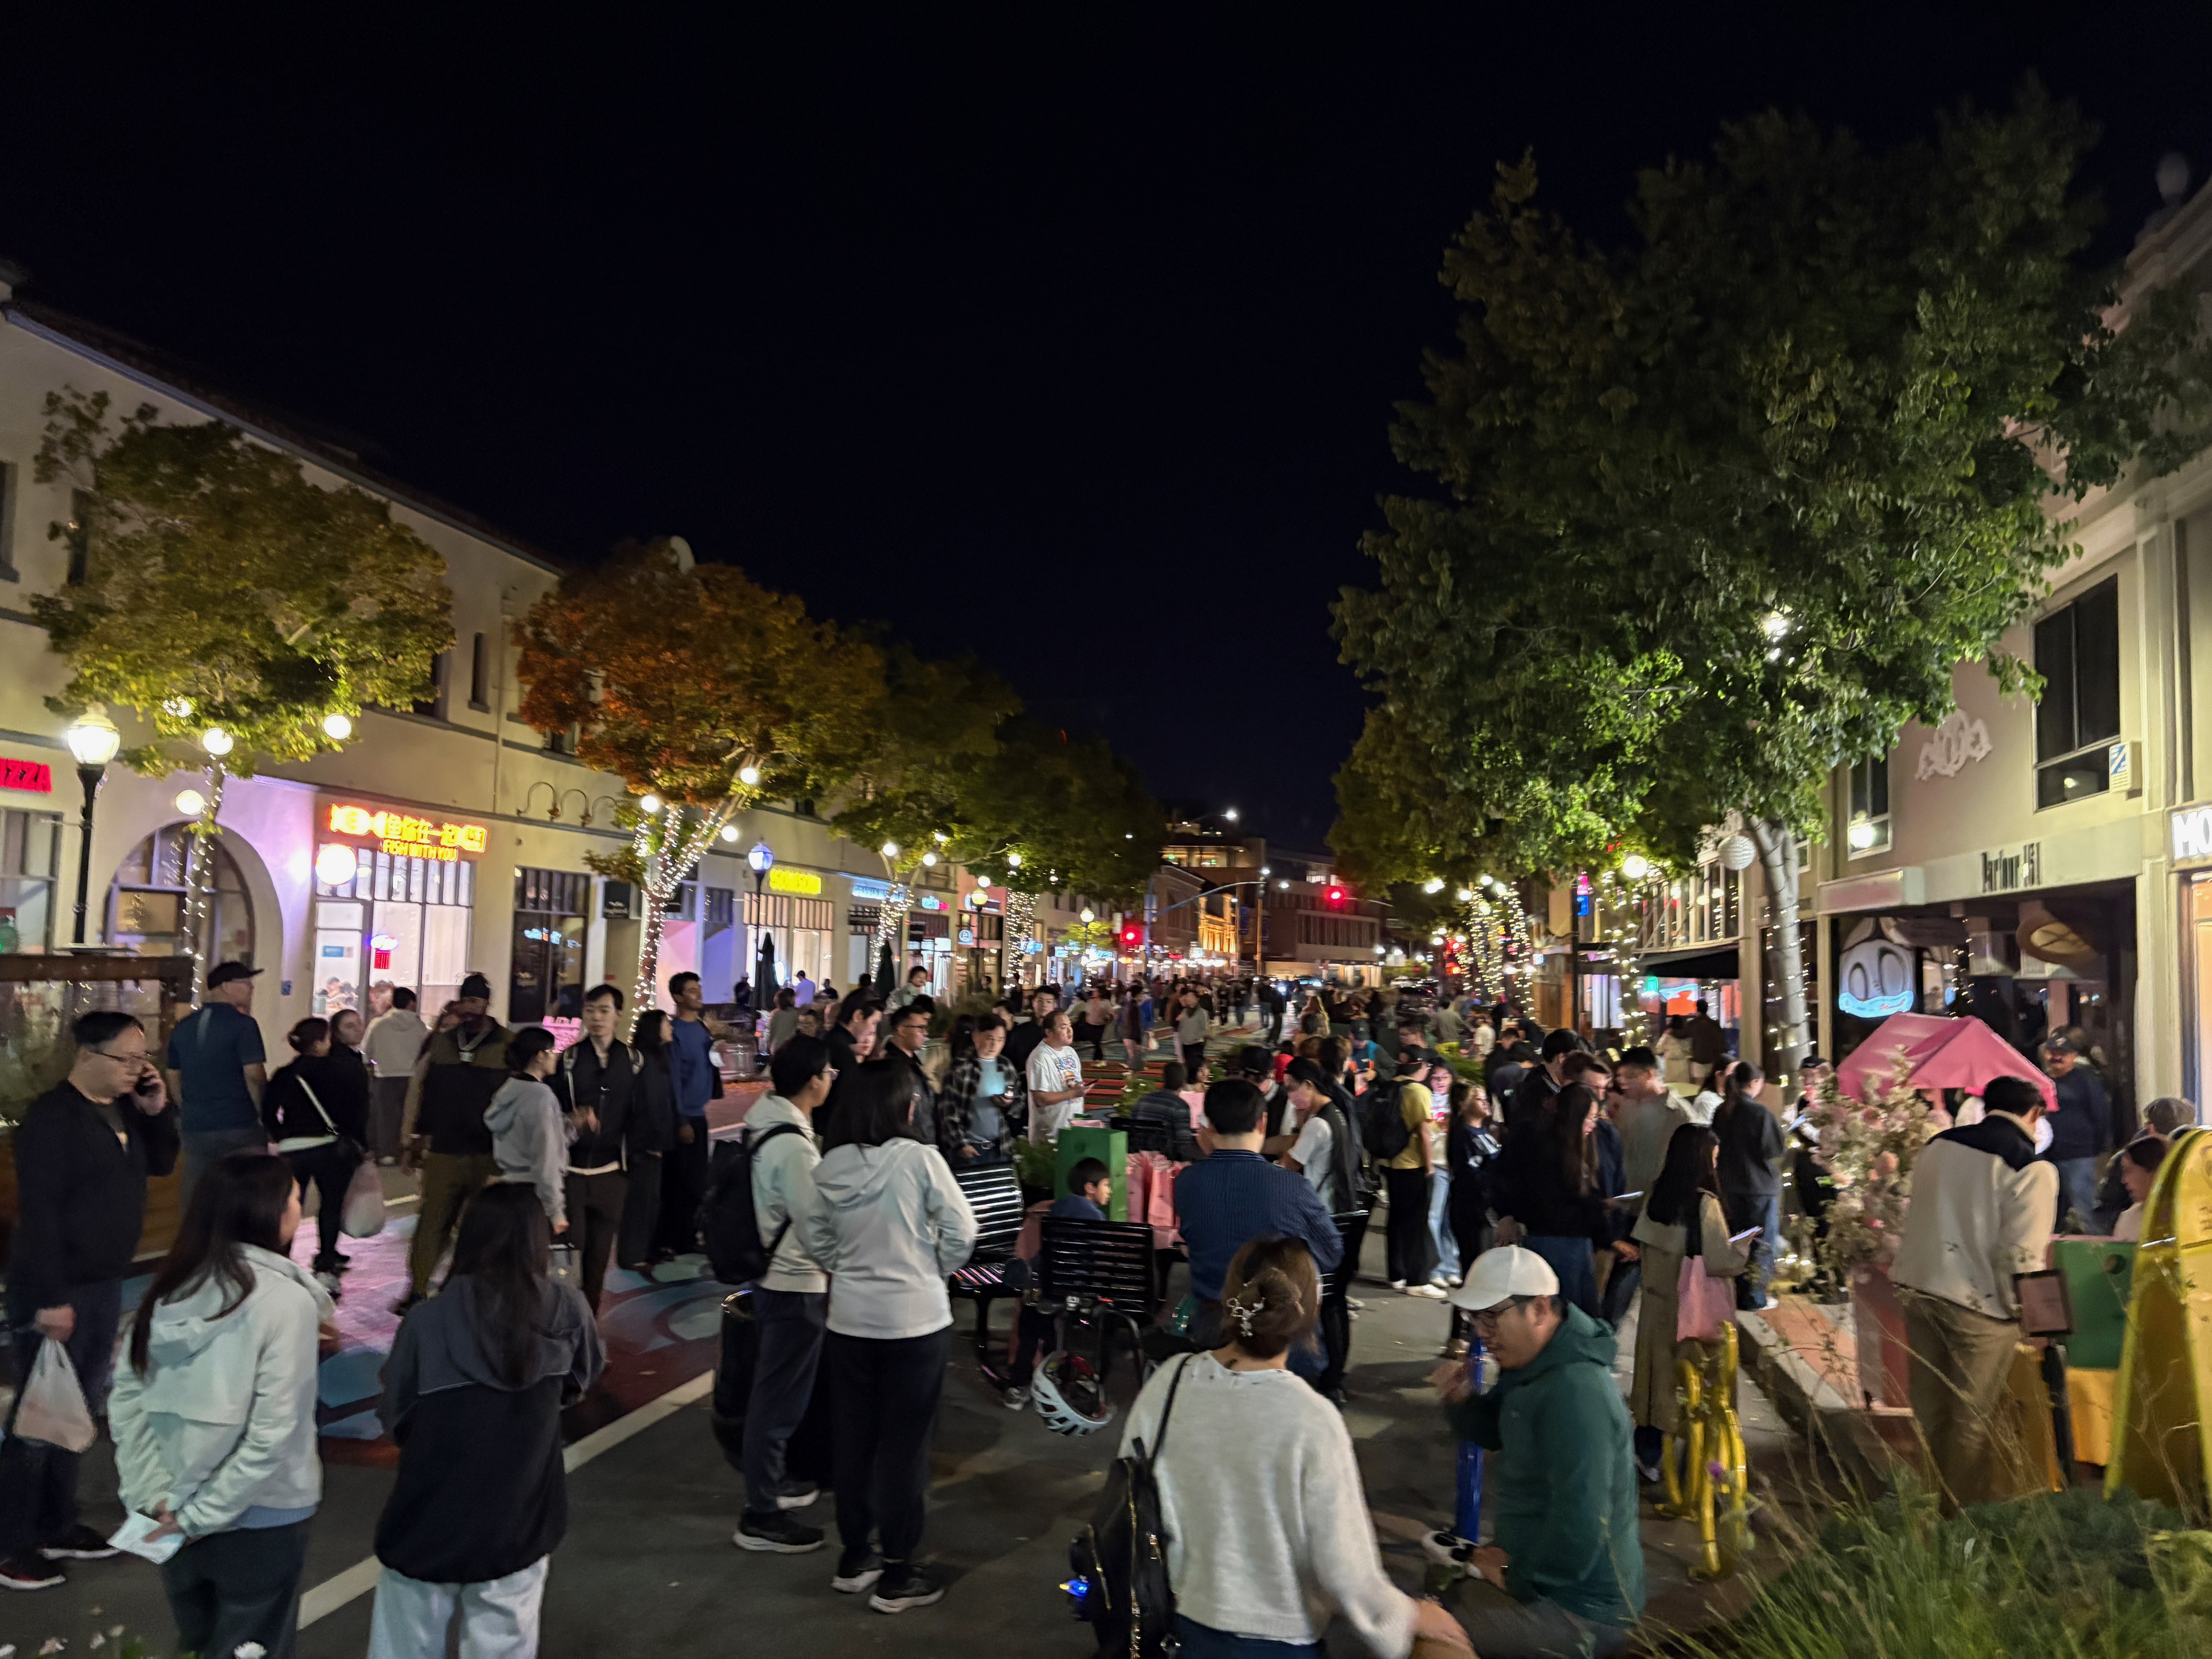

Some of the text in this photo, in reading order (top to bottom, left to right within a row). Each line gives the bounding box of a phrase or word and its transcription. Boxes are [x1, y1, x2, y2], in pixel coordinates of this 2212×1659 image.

[382, 839, 458, 862] FISH WITH YOU
